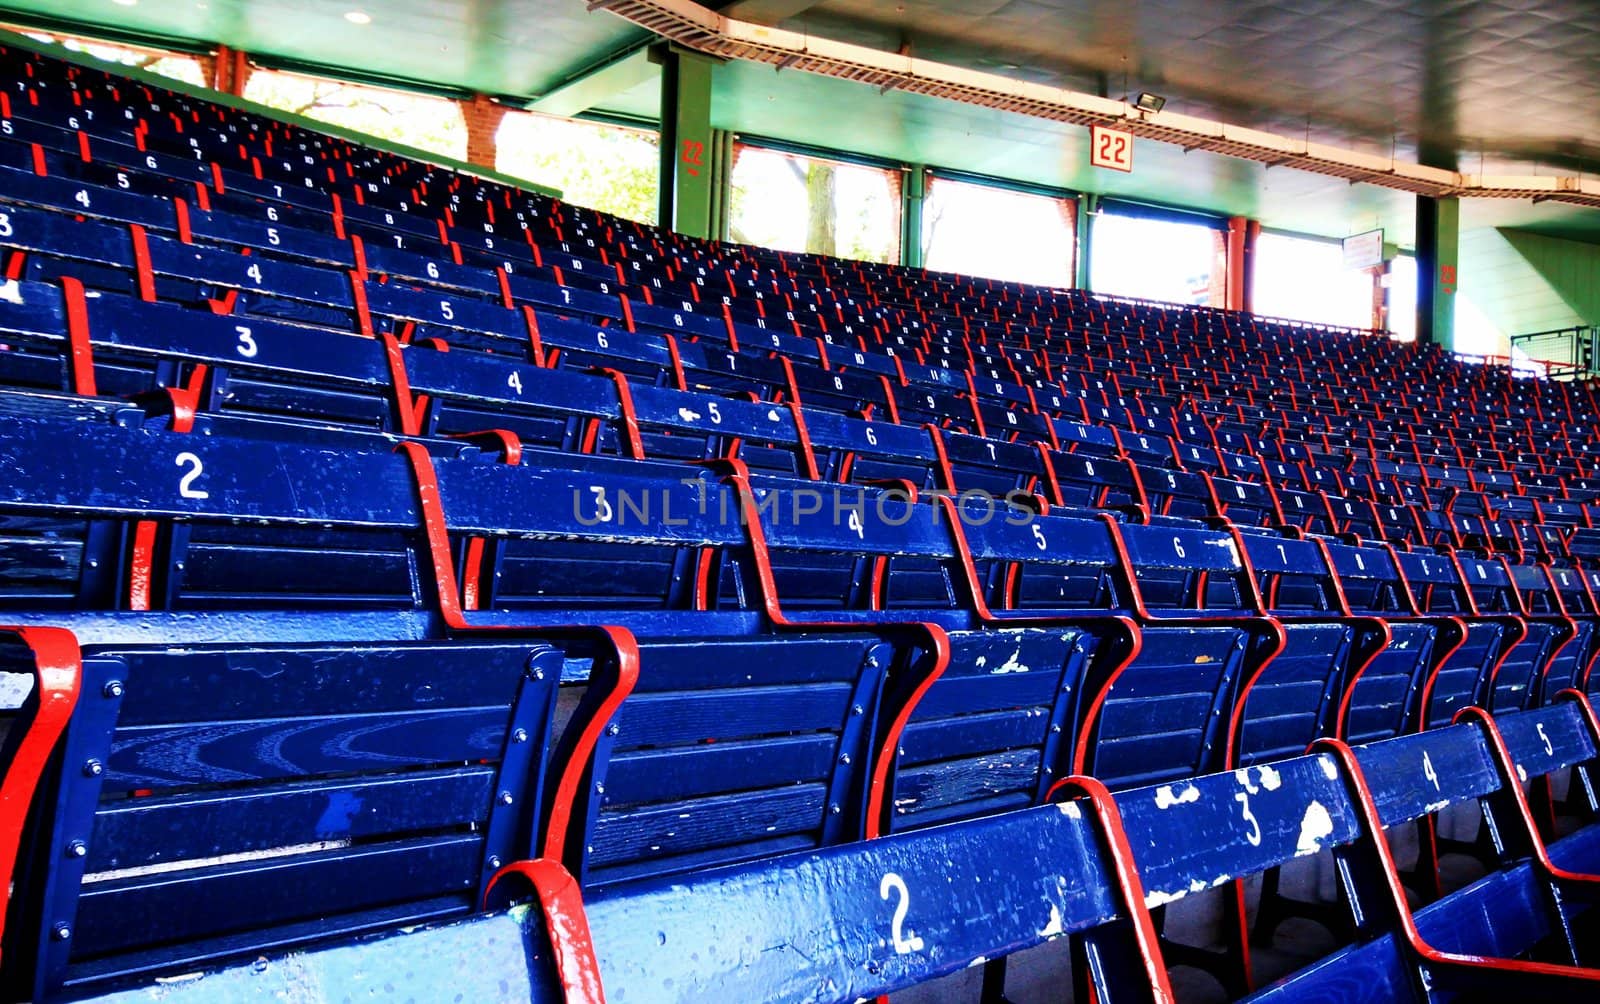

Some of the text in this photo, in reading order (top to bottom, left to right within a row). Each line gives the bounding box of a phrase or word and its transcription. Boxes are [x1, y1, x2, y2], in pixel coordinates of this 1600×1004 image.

[2, 120, 12, 134] 5
[69, 117, 79, 128] 6
[194, 149, 201, 159] 7
[681, 138, 704, 166] 22
[1099, 133, 1126, 164] 22
[146, 156, 157, 168] 6
[118, 173, 129, 188] 5
[76, 190, 90, 207] 4
[274, 186, 282, 197] 7
[268, 207, 278, 220] 6
[385, 214, 393, 224] 8
[268, 228, 280, 245] 5
[394, 236, 402, 248] 7
[247, 264, 262, 284] 4
[427, 263, 439, 278] 6
[504, 262, 512, 273] 8
[601, 283, 608, 293] 9
[653, 278, 661, 288] 11
[562, 290, 570, 303] 7
[441, 301, 453, 320] 5
[682, 301, 692, 312] 10
[674, 314, 683, 326] 8
[236, 326, 257, 357] 3
[598, 332, 608, 348] 6
[772, 335, 779, 346] 9
[825, 334, 833, 344] 12
[727, 355, 735, 370] 7
[855, 353, 864, 364] 10
[931, 370, 938, 380] 11
[508, 371, 522, 394] 4
[834, 377, 842, 390] 8
[927, 396, 934, 408] 9
[708, 402, 721, 424] 5
[1007, 412, 1017, 424] 10
[866, 428, 877, 445] 6
[1079, 427, 1087, 438] 11
[1140, 438, 1149, 448] 12
[987, 444, 995, 460] 7
[1086, 461, 1094, 475] 8
[175, 452, 208, 499] 2
[1168, 474, 1176, 488] 9
[1236, 486, 1245, 499] 10
[588, 485, 614, 524] 3
[1295, 496, 1303, 508] 11
[849, 509, 864, 539] 4
[1032, 524, 1046, 550] 5
[1174, 537, 1185, 558] 6
[1277, 545, 1287, 564] 7
[1355, 554, 1364, 570] 8
[1537, 723, 1553, 756] 5
[1424, 751, 1440, 791] 4
[1235, 792, 1261, 846] 3
[880, 872, 924, 954] 2
